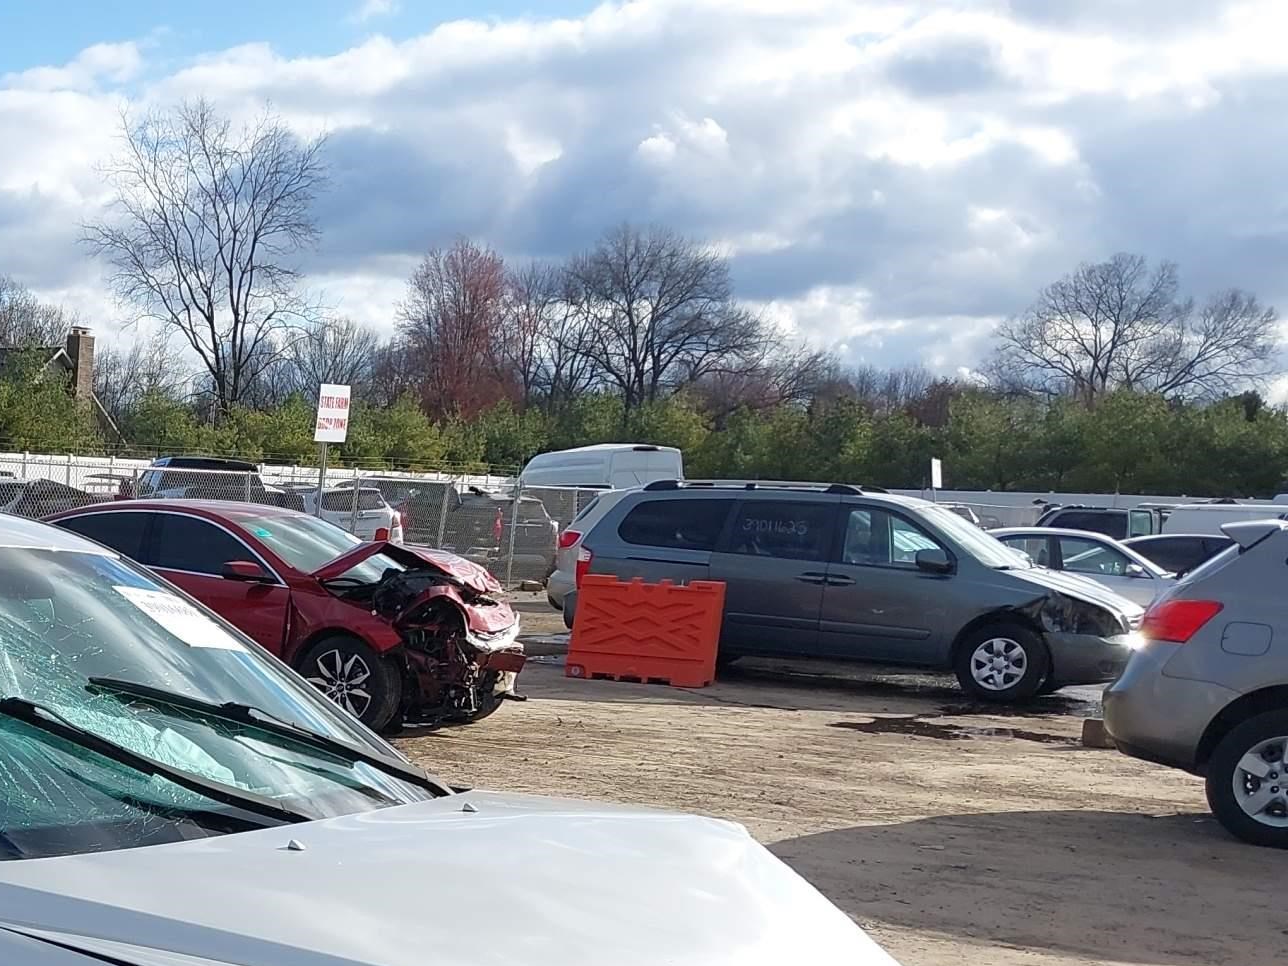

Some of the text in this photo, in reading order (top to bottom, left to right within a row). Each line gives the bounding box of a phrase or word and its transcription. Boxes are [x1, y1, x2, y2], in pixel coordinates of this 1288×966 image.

[320, 396, 348, 409] STATE FARM
[333, 418, 346, 430] ZONE
